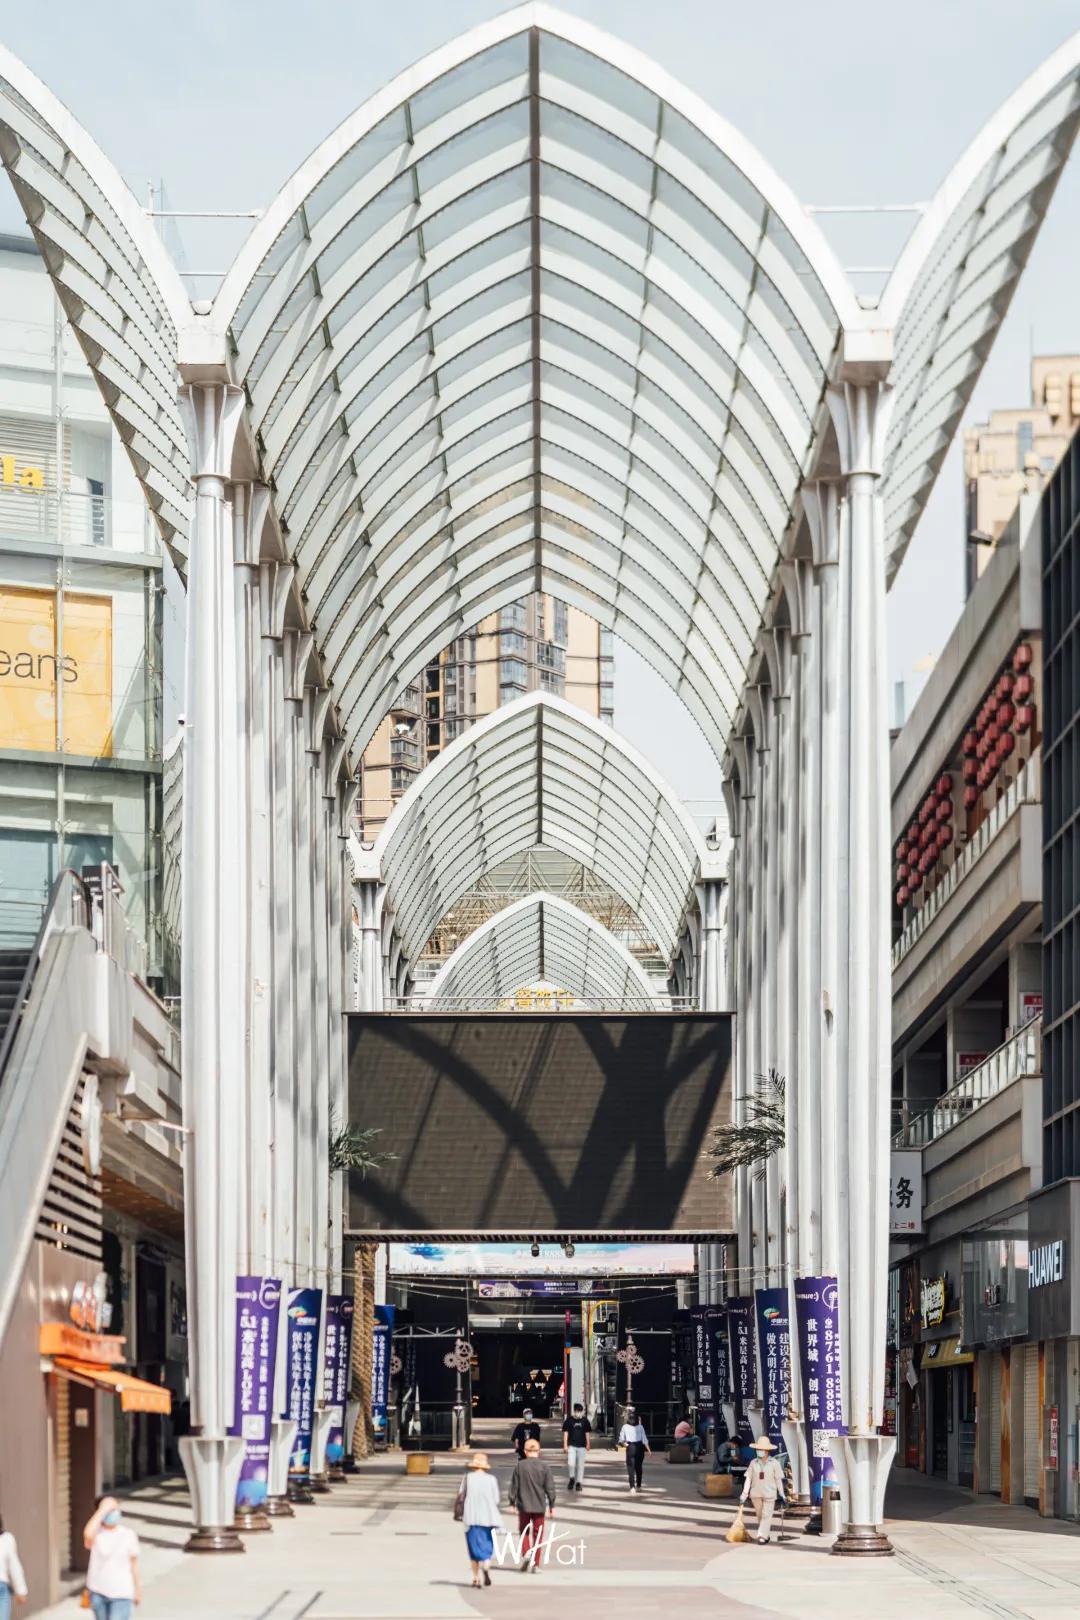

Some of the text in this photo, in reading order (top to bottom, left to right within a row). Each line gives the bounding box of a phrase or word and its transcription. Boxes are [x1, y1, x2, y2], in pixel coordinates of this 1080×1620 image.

[890, 1177, 914, 1208] 务
[1028, 1239, 1063, 1289] HUAWEI
[766, 1332, 779, 1430] 做文明有礼武汉人
[806, 1318, 819, 1422] 世界城·创世界
[825, 1330, 835, 1422] 8761 8888
